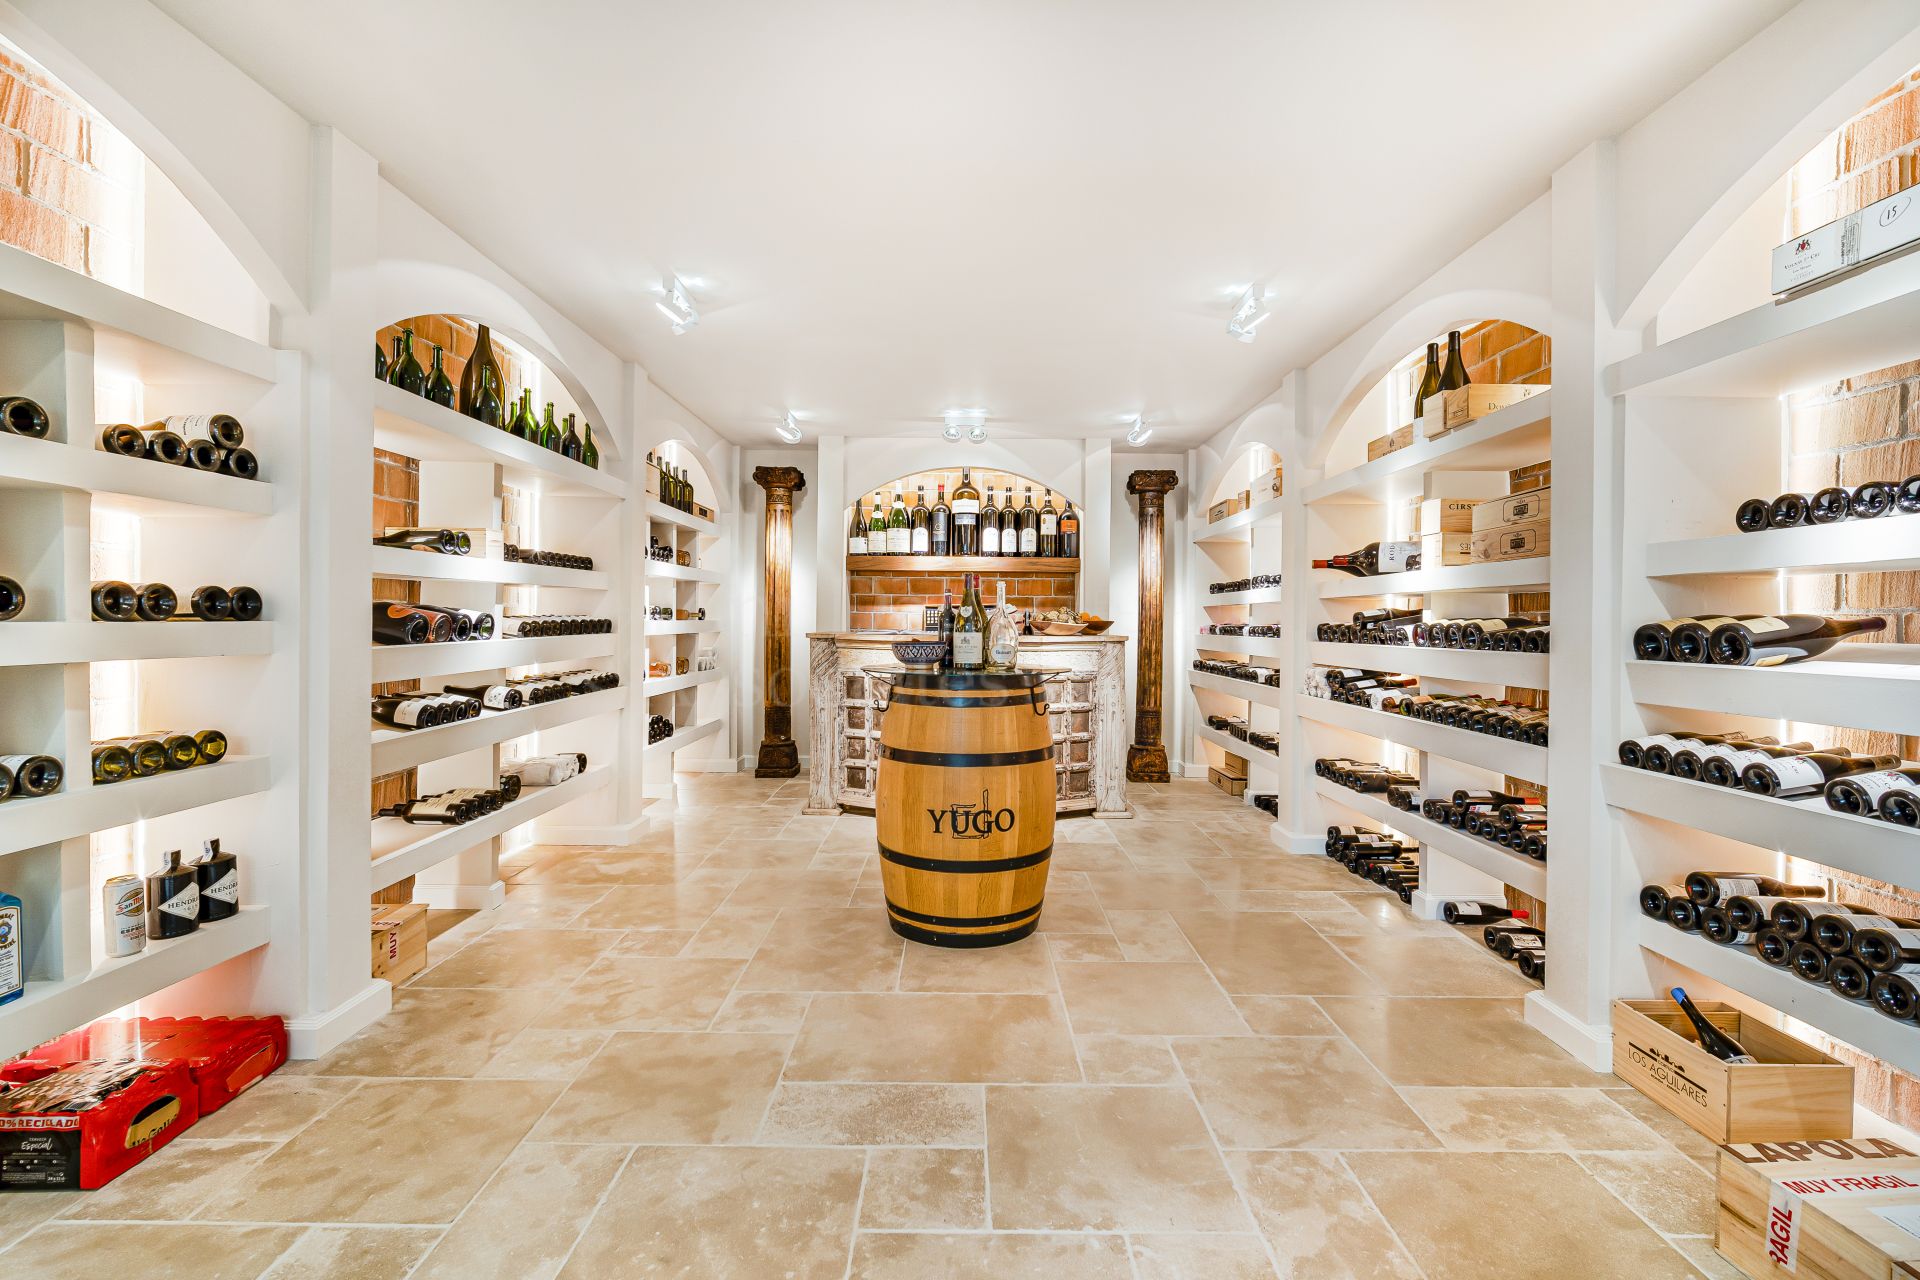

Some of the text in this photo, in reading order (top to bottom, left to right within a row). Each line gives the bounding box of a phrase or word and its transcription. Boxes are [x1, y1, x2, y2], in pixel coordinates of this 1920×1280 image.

[1449, 503, 1476, 511] CIRS
[927, 808, 1015, 834] YUGO
[389, 932, 397, 960] MUY
[1628, 1048, 1647, 1068] LOS
[1649, 1064, 1708, 1108] AGUILARES
[21, 1137, 53, 1152] Especial
[1719, 1138, 1919, 1163] LAPOLA
[1781, 1174, 1920, 1195] MUY FRAGIL
